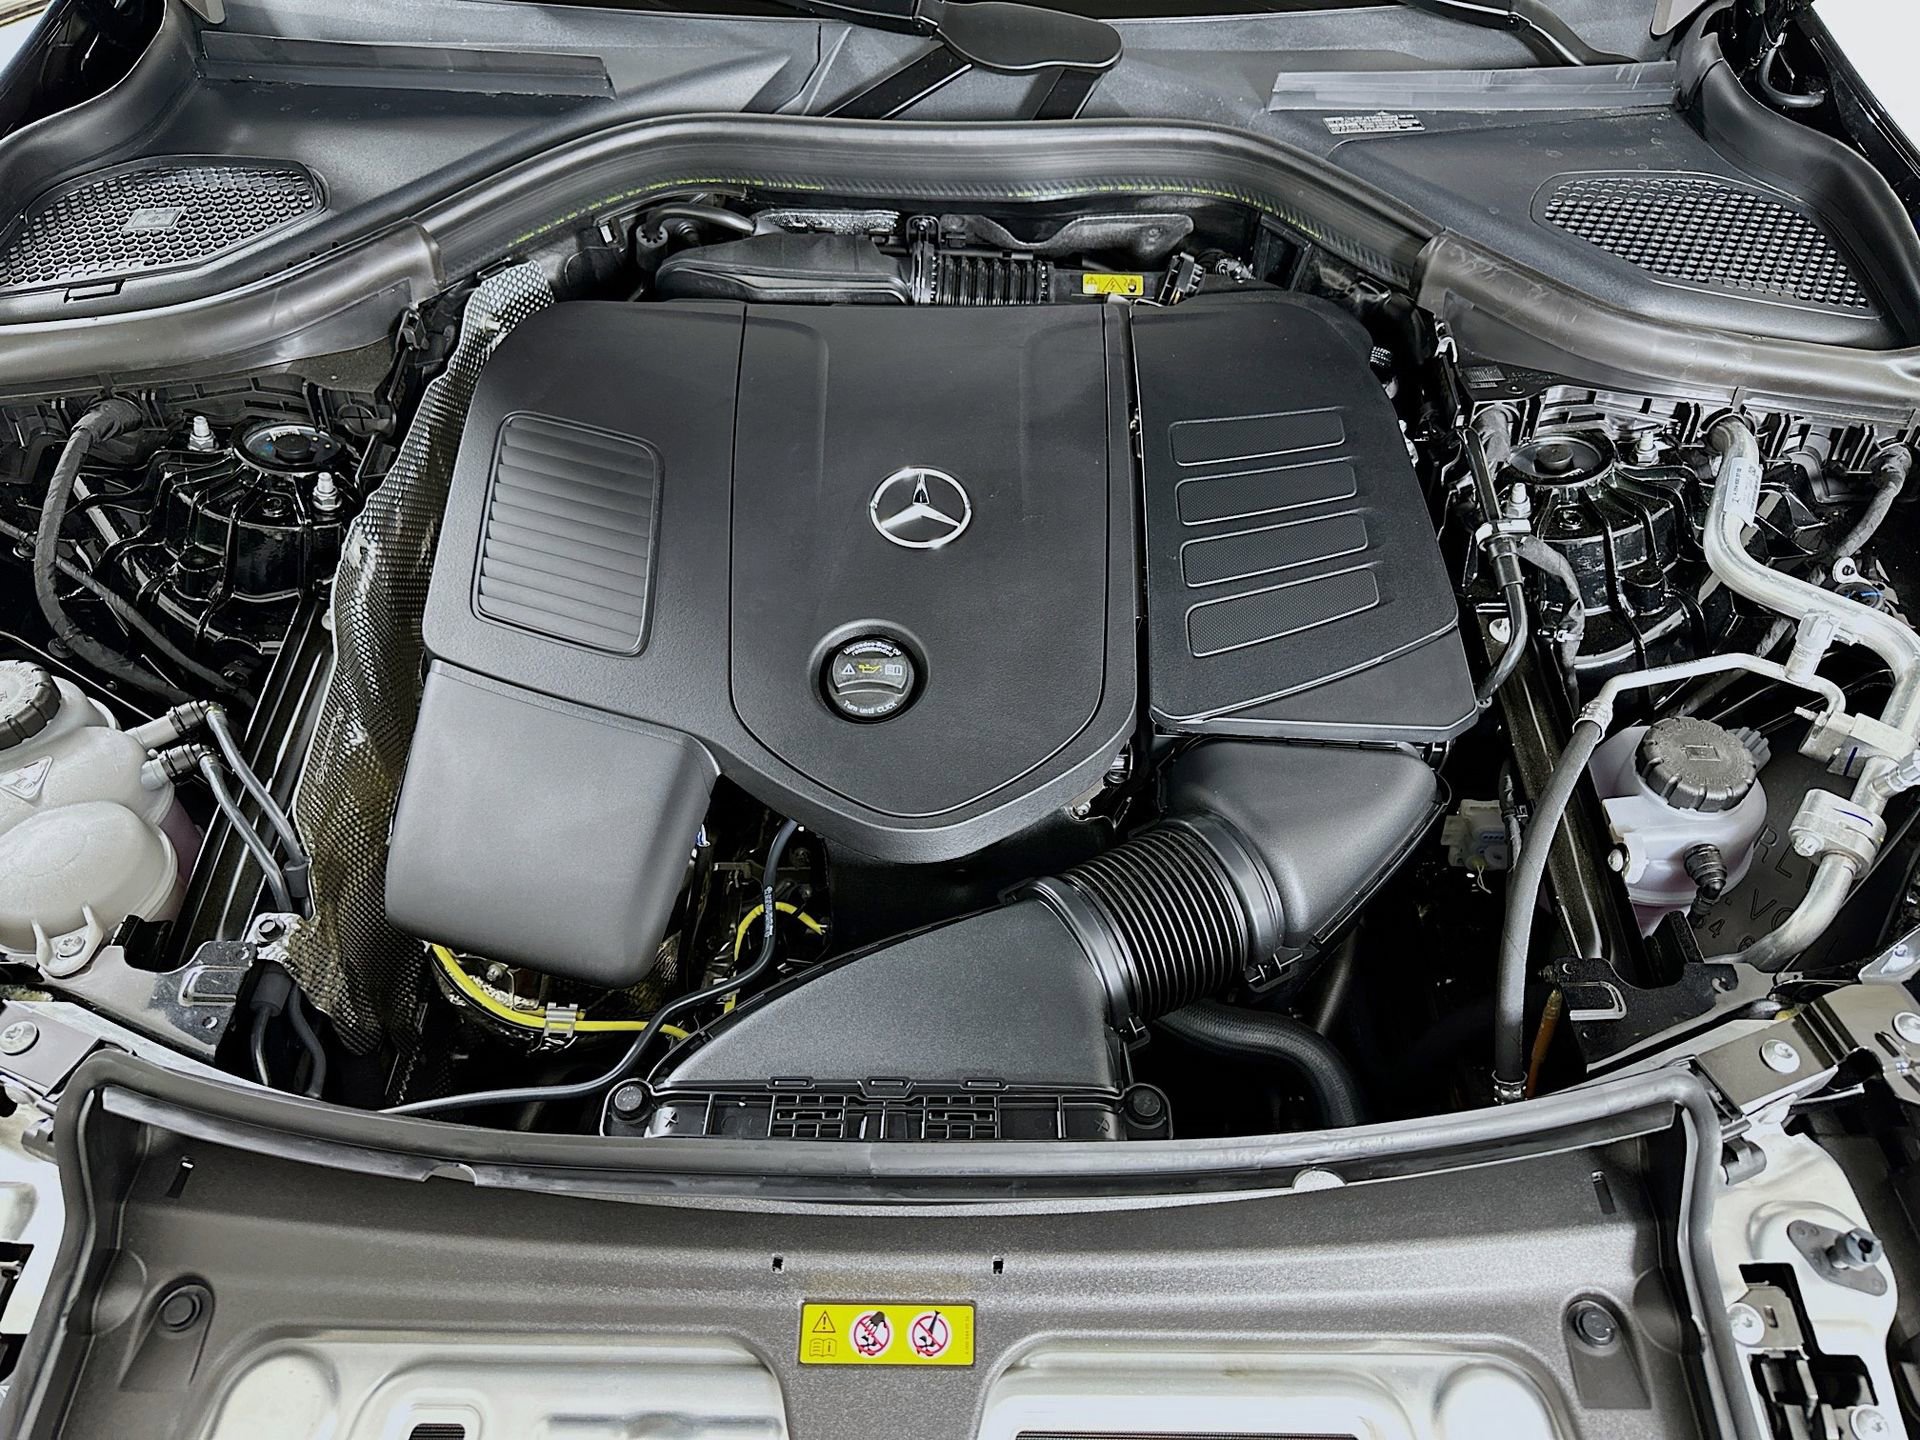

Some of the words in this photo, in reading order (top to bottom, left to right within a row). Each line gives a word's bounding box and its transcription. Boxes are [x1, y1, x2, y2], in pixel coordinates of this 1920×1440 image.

[852, 646, 894, 657] recommended
[843, 700, 858, 712] Turn
[877, 701, 898, 713] CLICK
